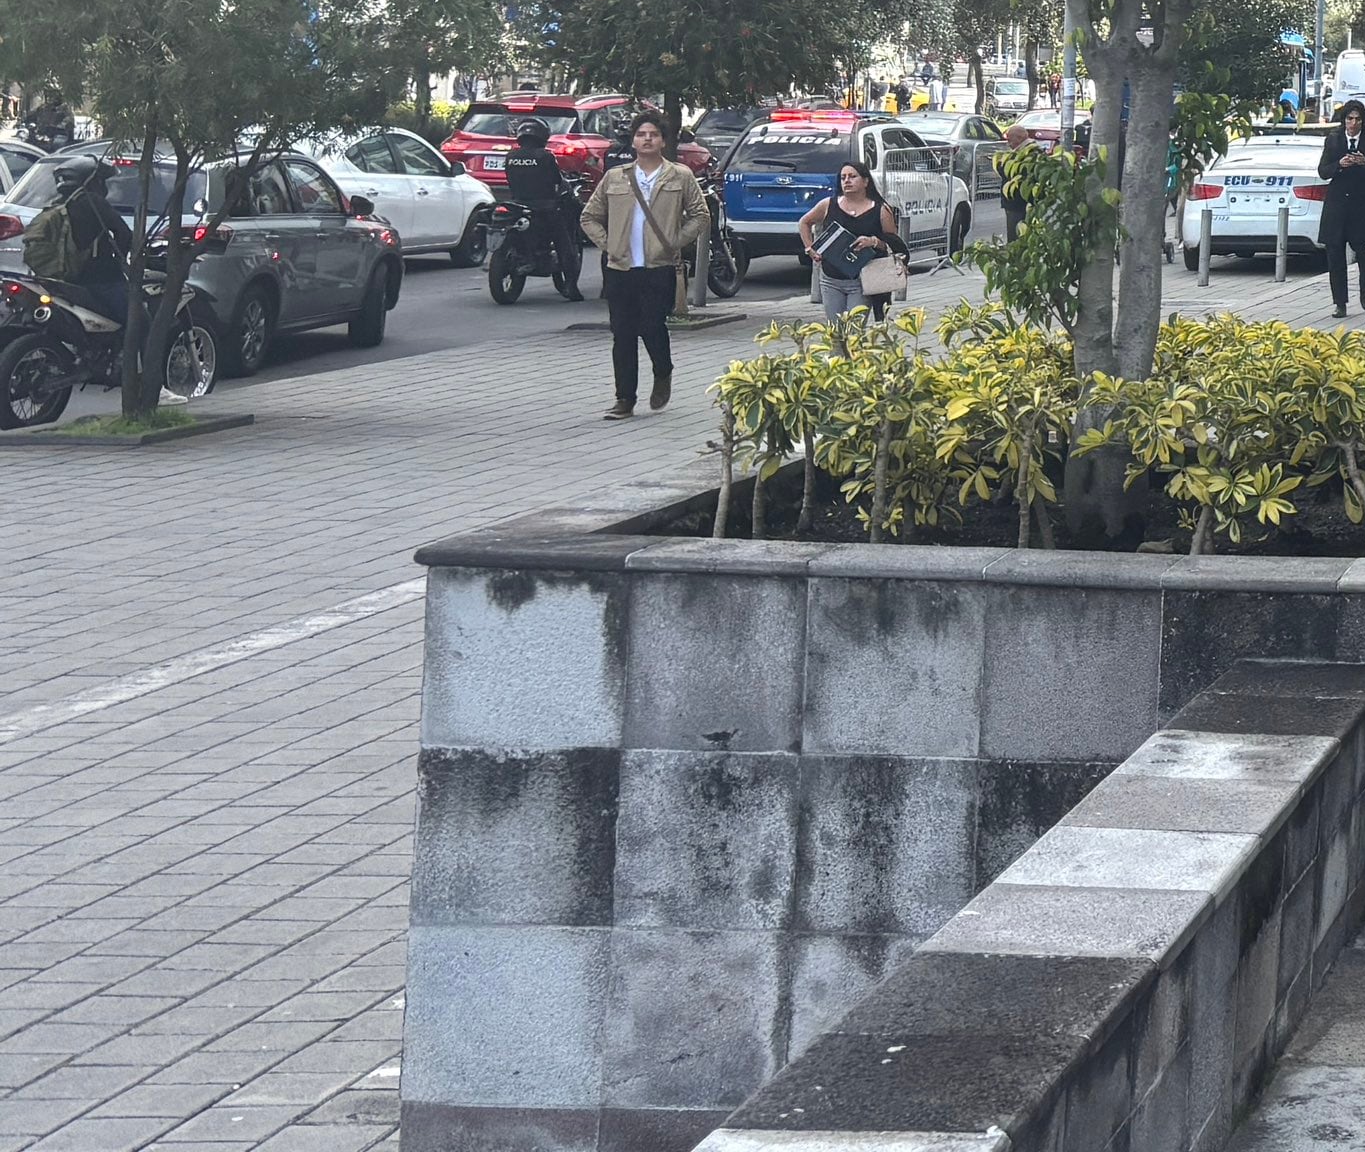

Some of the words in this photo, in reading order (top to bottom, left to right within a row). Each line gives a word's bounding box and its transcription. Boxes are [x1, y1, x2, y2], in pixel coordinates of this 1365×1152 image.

[747, 135, 842, 146] POLICIA
[508, 158, 538, 166] POLICIA
[1224, 175, 1252, 186] ECU
[1265, 176, 1294, 186] 911
